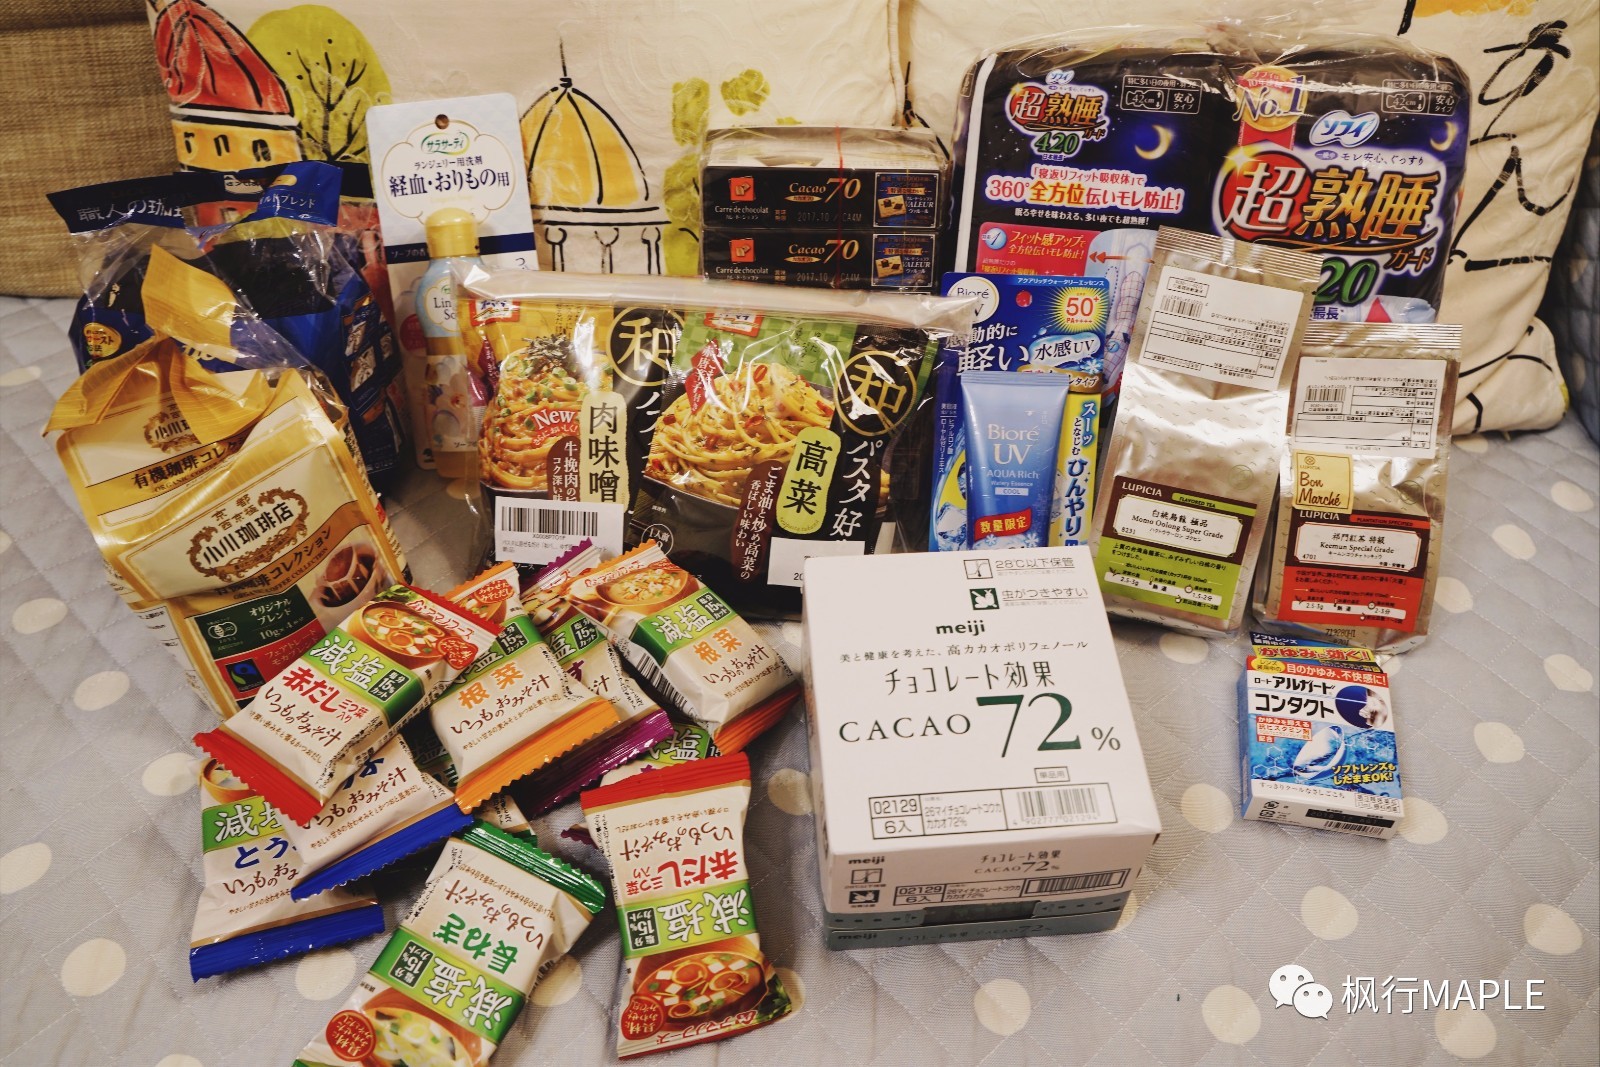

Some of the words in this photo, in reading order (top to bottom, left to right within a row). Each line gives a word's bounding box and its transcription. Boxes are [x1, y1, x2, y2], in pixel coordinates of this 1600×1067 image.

[1013, 90, 1104, 126] 超熟睡
[1173, 92, 1196, 103] 安心
[1435, 94, 1455, 105] 安心
[1321, 117, 1374, 137] ソフィ
[427, 138, 465, 151] サラサーティ
[1034, 132, 1079, 154] 420
[414, 155, 483, 170] ランジェリー用洗剤
[389, 168, 510, 198] 経血・おりもの用
[789, 182, 826, 194] Cacao
[825, 178, 862, 203] 70
[1222, 165, 1441, 241] 超熟睡
[788, 244, 825, 255] Cacao
[824, 239, 860, 264] 70
[1385, 250, 1434, 273] ガード
[617, 317, 676, 371] 和
[533, 409, 576, 430] New
[988, 424, 1040, 441] Bioré
[993, 443, 1032, 465] UV
[783, 440, 833, 515] 高菜
[987, 470, 1016, 479] AQUA
[1018, 470, 1040, 479] Rich
[1300, 471, 1324, 487] Bon
[829, 439, 884, 542] パスタ好
[1063, 459, 1088, 537] ひんやり
[1122, 481, 1163, 497] LUPICIA
[1300, 488, 1342, 506] Marché
[212, 494, 251, 521] 京都
[1300, 510, 1340, 521] LUPICIA
[202, 501, 295, 566] 小川珈琲店
[979, 515, 1029, 534] 数量限定
[1131, 515, 1154, 527] Momo
[1155, 519, 1181, 533] Oolong
[1182, 525, 1202, 537] Super
[1203, 529, 1224, 540] Grade
[1320, 541, 1347, 551] Keemun
[1349, 544, 1372, 553] Special
[1373, 546, 1395, 555] Grade
[1002, 586, 1088, 600] 虫がつきやすい
[249, 598, 292, 616] オリジナル
[257, 609, 292, 625] ブレンド
[650, 604, 715, 644] 減塩
[935, 620, 986, 637] meiji
[693, 628, 743, 665] 根菜
[309, 635, 386, 691] 減塩
[702, 644, 770, 685] いつものおみそ汁
[458, 661, 524, 710] 根菜
[885, 660, 1055, 695] チョコレート効果
[1254, 676, 1272, 685] ロート
[1272, 675, 1336, 695] アルガード
[282, 666, 342, 714] 赤だし
[338, 699, 370, 720] 三つ葉
[450, 673, 551, 735] いつものおみそ汁
[1255, 693, 1335, 719] コンタクト
[265, 686, 343, 748] いつものおみそ汁
[839, 714, 971, 743] CACAO
[1332, 763, 1397, 775] ソフトレンズも
[873, 798, 917, 816] 02129
[884, 820, 913, 835] 6入
[620, 821, 734, 861] いつものおみそ汁
[234, 836, 297, 869] とう
[848, 856, 885, 867] meiji
[981, 850, 1061, 865] チョコレート効果
[633, 865, 650, 878] 入り
[657, 849, 738, 889] 赤だし
[974, 865, 1021, 875] CACAO
[625, 876, 662, 897] 三つ葉
[899, 885, 942, 897] 02129
[445, 879, 545, 951] いつものおみそ汁
[628, 909, 652, 920] カット
[657, 887, 749, 942] 減塩
[433, 913, 517, 974] 長ねぎ
[838, 932, 877, 942] meiji
[407, 943, 431, 962] カット
[423, 957, 513, 1031] 減塩
